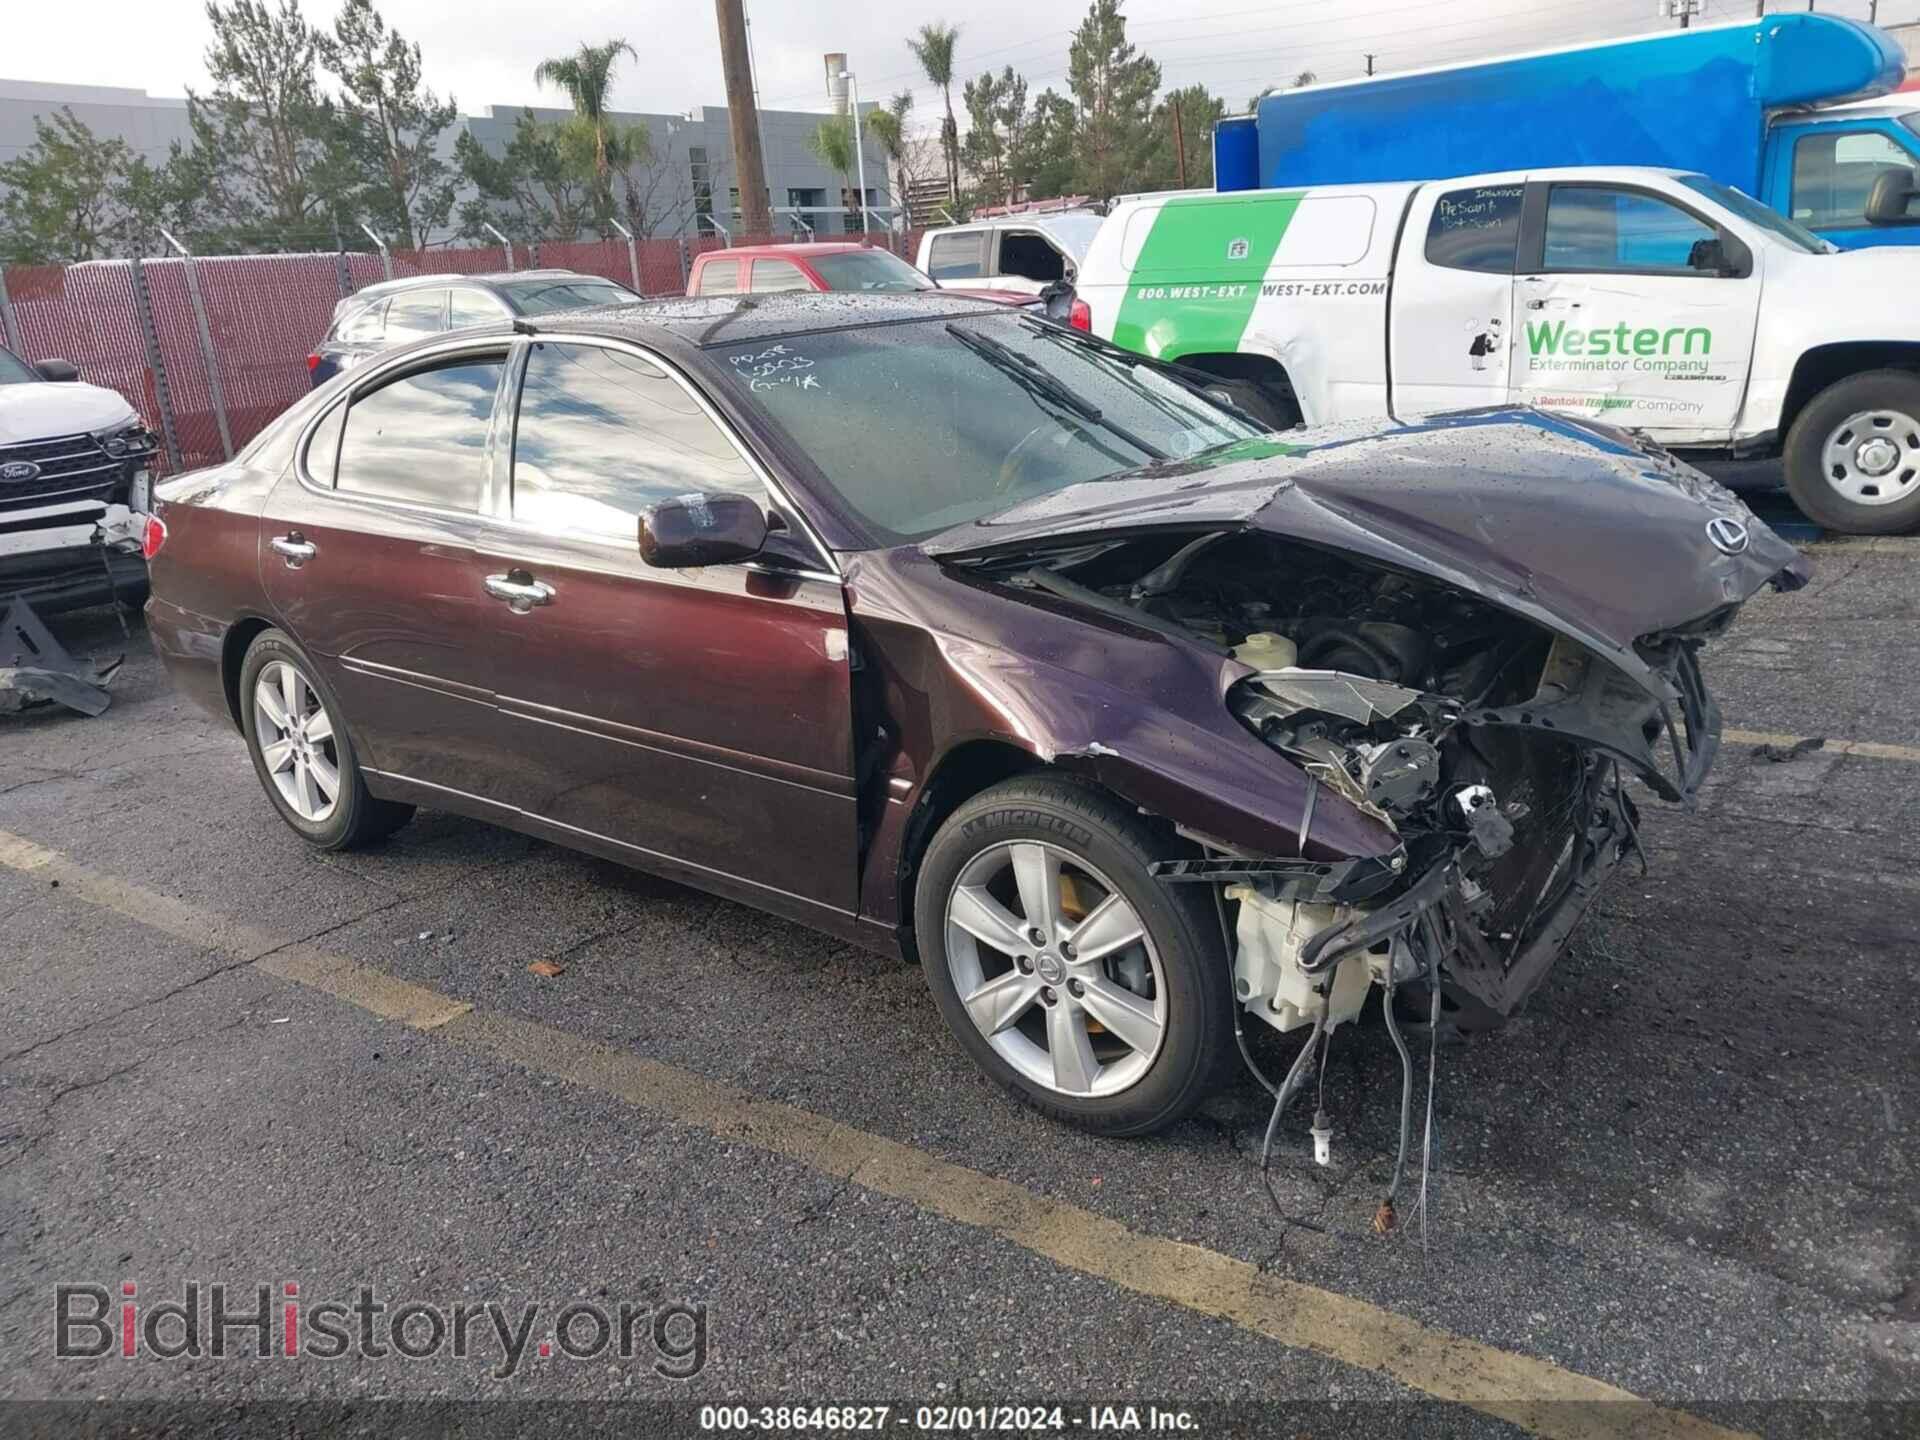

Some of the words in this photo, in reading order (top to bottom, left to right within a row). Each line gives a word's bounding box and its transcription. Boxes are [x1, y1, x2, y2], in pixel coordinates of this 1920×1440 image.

[1440, 199, 1457, 216] Pre
[1137, 284, 1248, 300] 800.WEST-EXT
[1262, 283, 1386, 297] WEST-EXT.COM
[1526, 320, 1712, 356] Western
[1529, 357, 1629, 372] Exterminator
[1633, 357, 1709, 375] Company
[1636, 399, 1704, 415] Company
[3, 466, 30, 478] Ford
[984, 809, 1093, 844] MICHELIN
